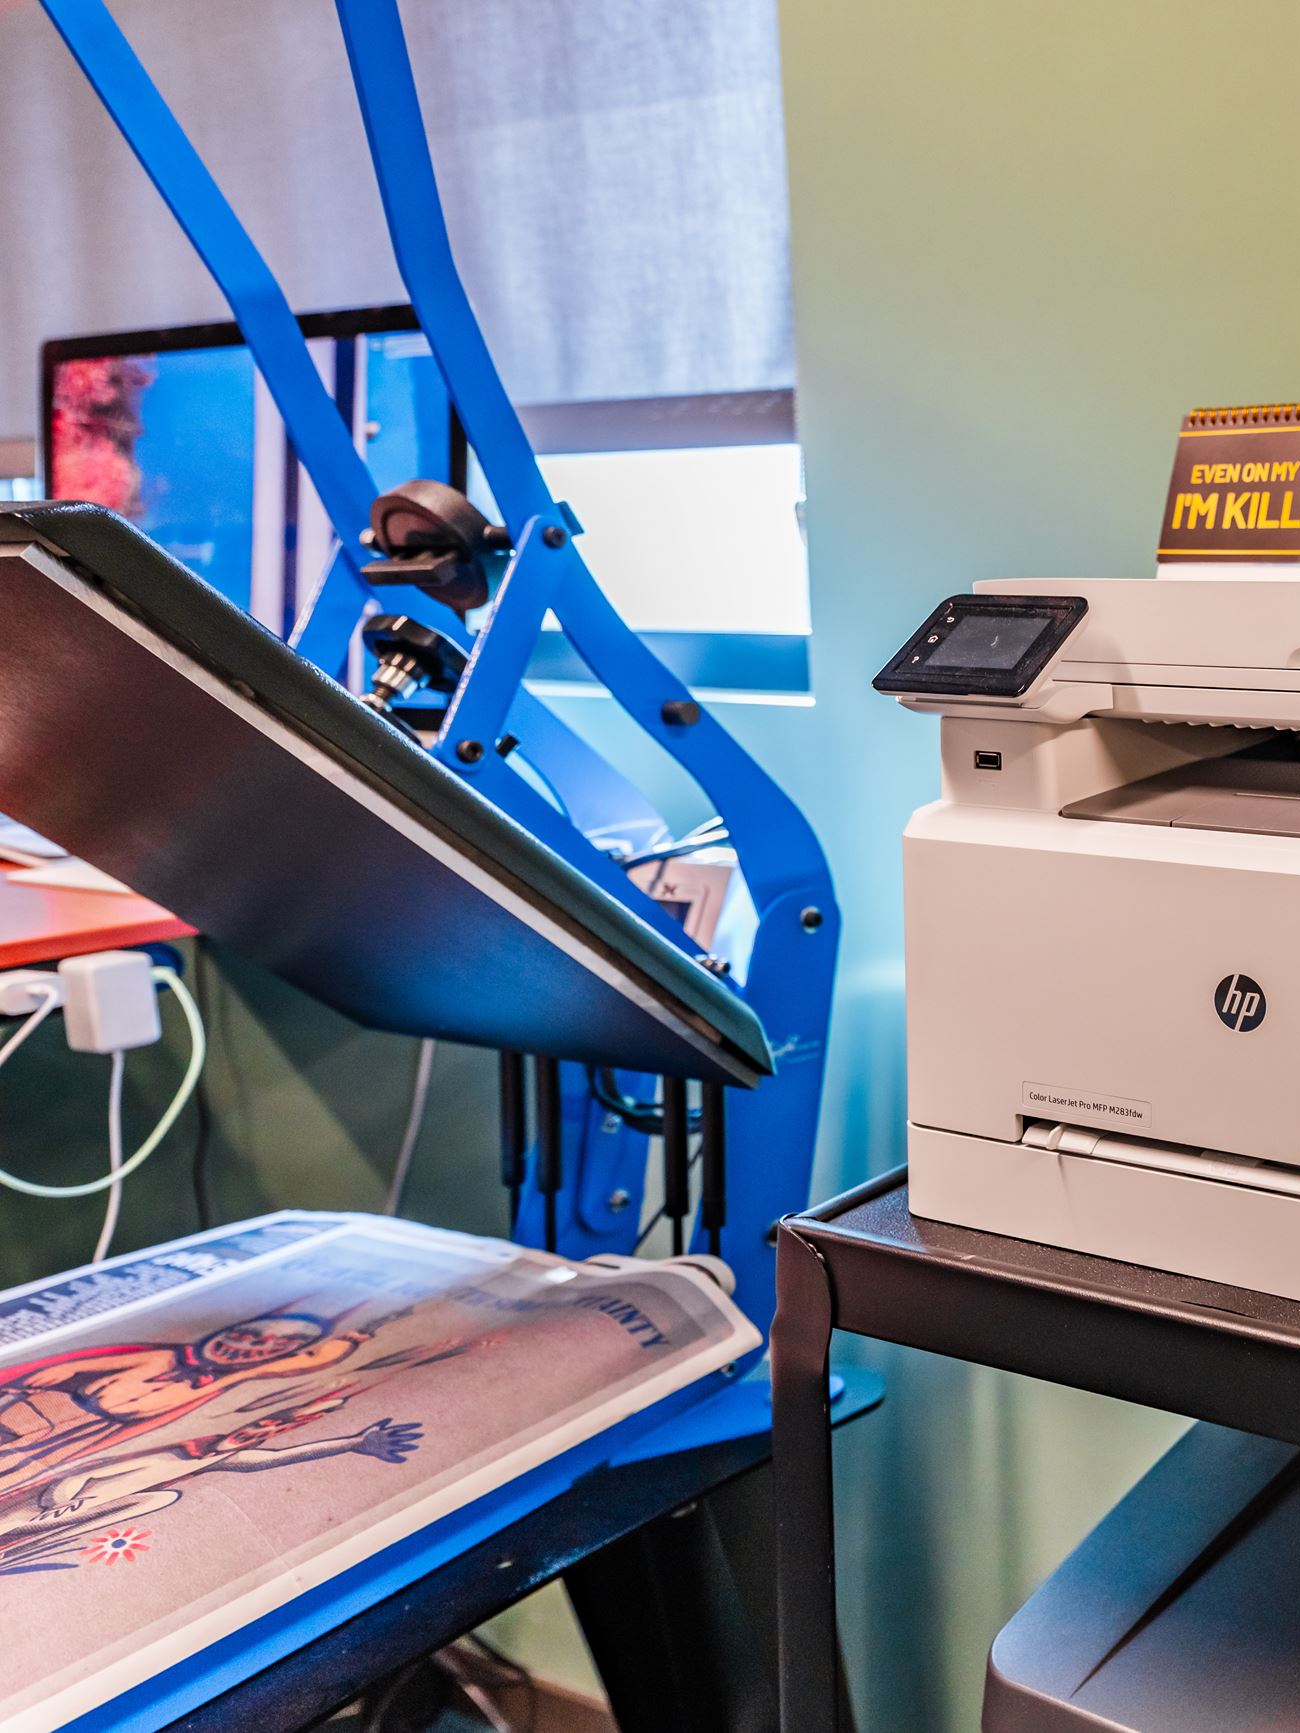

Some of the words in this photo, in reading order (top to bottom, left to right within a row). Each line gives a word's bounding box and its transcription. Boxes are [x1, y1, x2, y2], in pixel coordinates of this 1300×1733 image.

[1190, 463, 1242, 485] EVEN
[1242, 462, 1272, 483] ON
[1271, 461, 1300, 482] MY
[1171, 491, 1220, 530] I'M
[1221, 973, 1261, 1032] hp
[1029, 1091, 1048, 1103] Color
[1048, 1095, 1078, 1108] LaserJet
[1078, 1100, 1092, 1110] Pro
[1092, 1103, 1108, 1113] MFP
[1108, 1105, 1144, 1119] M283fdw
